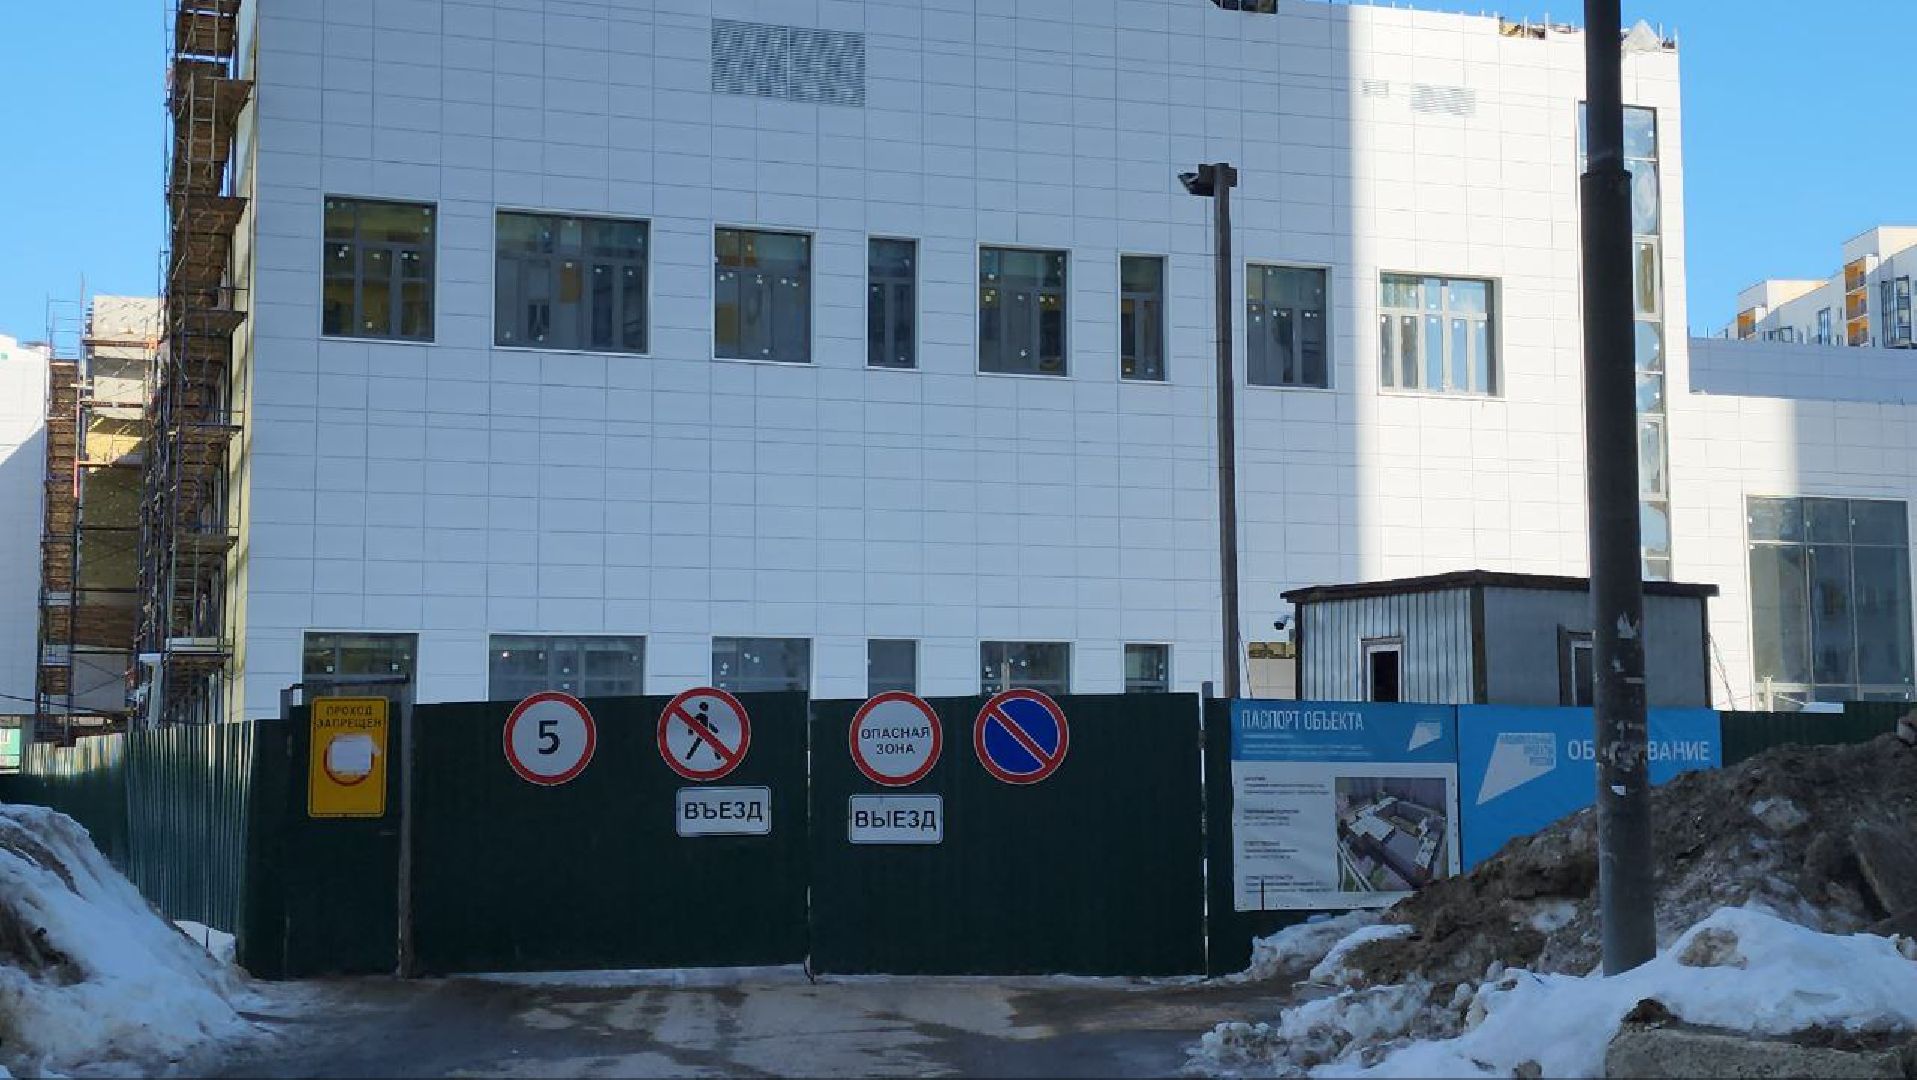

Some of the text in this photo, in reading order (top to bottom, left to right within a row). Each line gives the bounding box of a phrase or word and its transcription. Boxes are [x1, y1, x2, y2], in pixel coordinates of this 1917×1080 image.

[326, 704, 373, 716] ПРОХОД
[1241, 709, 1364, 731] ПАСПОРТ ОБЪЕКТА
[538, 719, 561, 755] 5
[861, 727, 930, 740] ОПАСНАЯ
[876, 743, 916, 755] ЗОНА
[1567, 739, 1711, 761] ОБВАНИЕ
[684, 802, 764, 823] ВЪЕЗД
[855, 810, 937, 831] ВЫЕЗД
